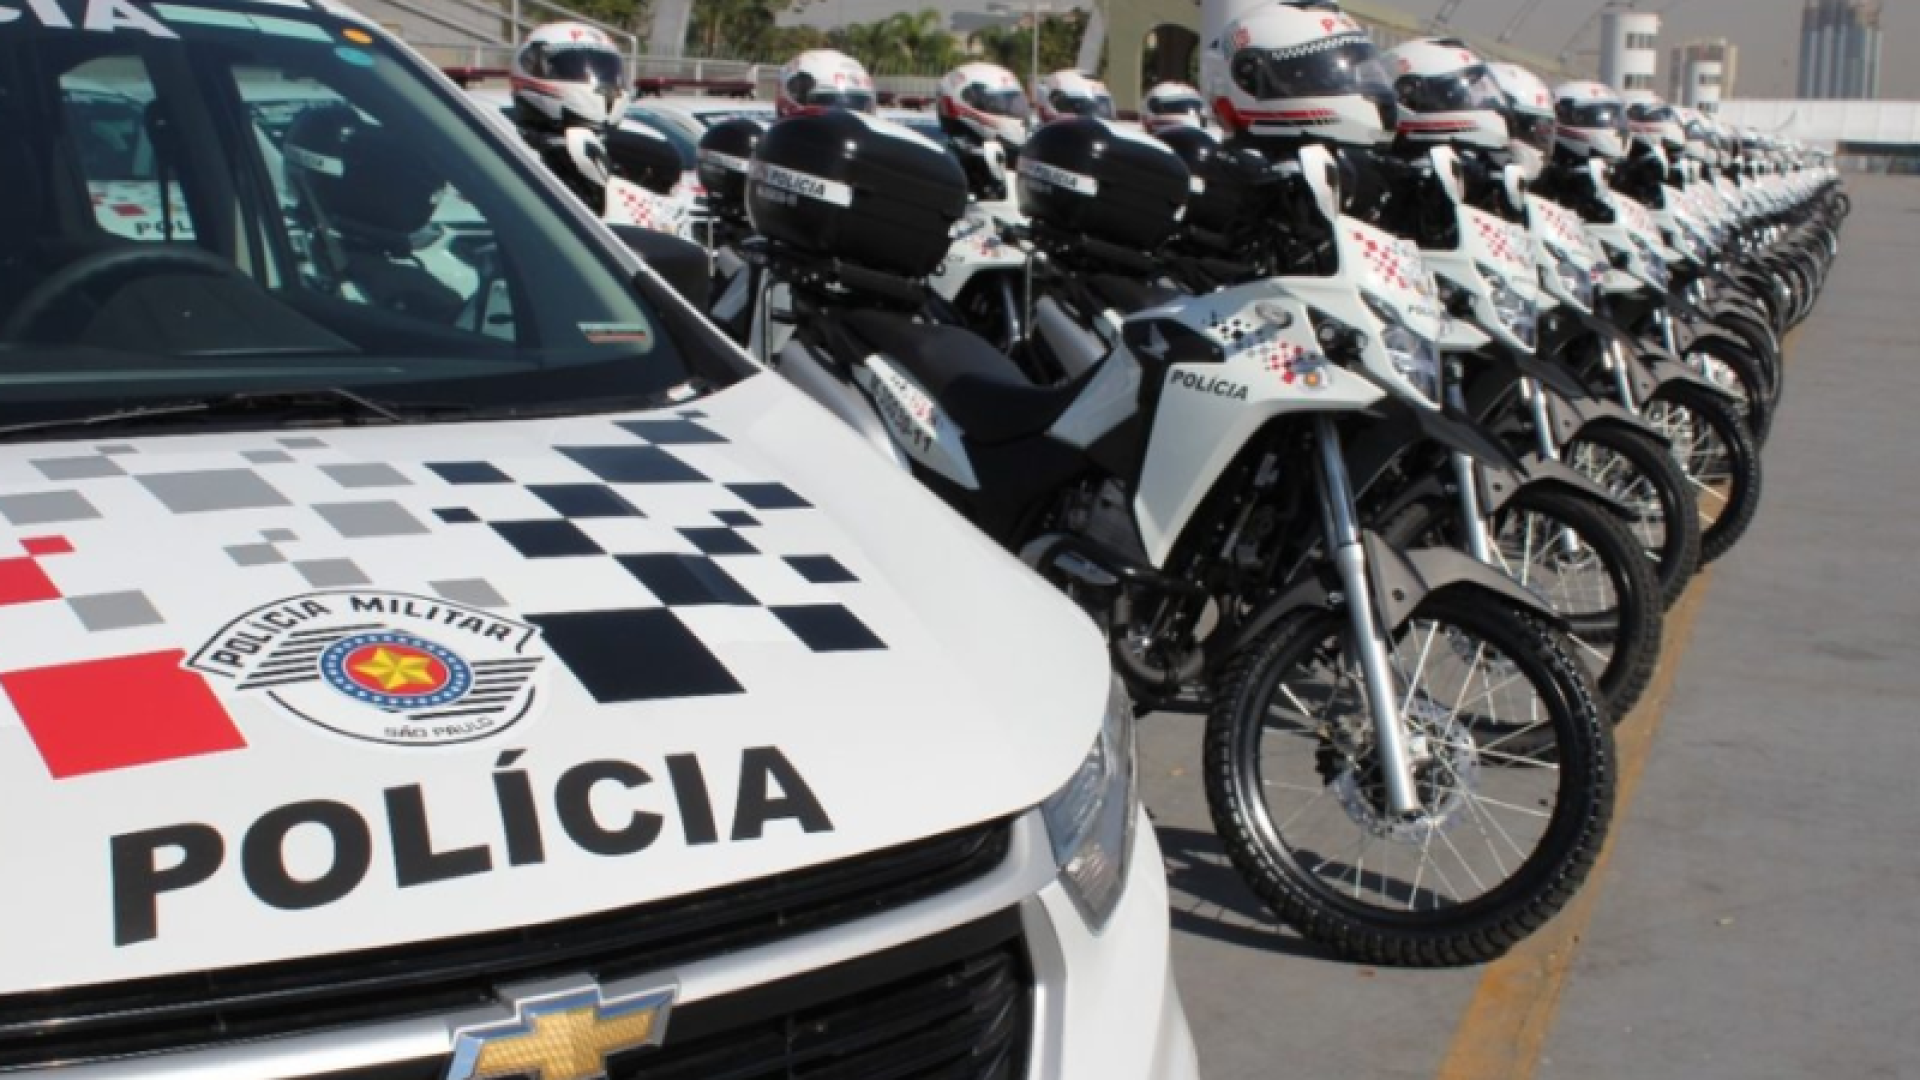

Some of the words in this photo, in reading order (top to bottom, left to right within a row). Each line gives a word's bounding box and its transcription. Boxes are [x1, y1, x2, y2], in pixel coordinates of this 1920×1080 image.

[0, 0, 180, 39] IA
[1171, 369, 1248, 401] POLÍCIA
[350, 595, 512, 642] MILITAR
[432, 715, 495, 737] PAULO
[110, 745, 834, 947] POLÍCIA
